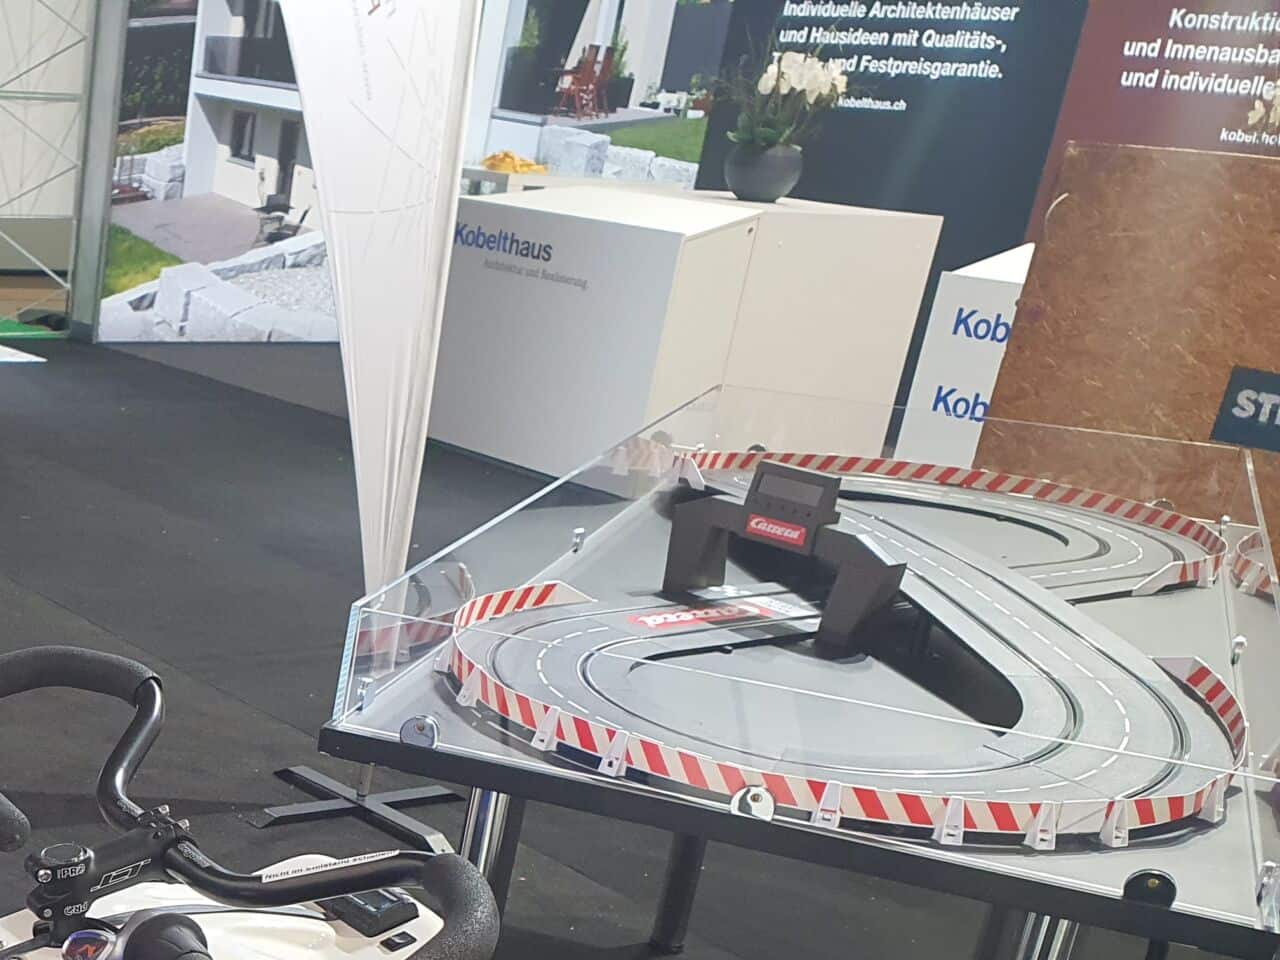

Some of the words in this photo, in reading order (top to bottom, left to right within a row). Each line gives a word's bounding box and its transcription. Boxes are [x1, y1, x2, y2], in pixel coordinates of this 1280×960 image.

[783, 0, 866, 18] Individuelle
[869, 0, 1019, 21] Architektenhäuser
[779, 27, 808, 43] und
[810, 28, 889, 46] Hausideen
[892, 30, 919, 47] mit
[922, 30, 1007, 52] Qualitäts-,
[1123, 38, 1162, 57] und
[860, 55, 1003, 79] Festpreisgarantie.
[1121, 69, 1159, 88] und
[454, 222, 553, 262] Kobelthaus
[952, 307, 1012, 343] Kob
[932, 385, 990, 422] Kob
[1231, 389, 1280, 426] ST
